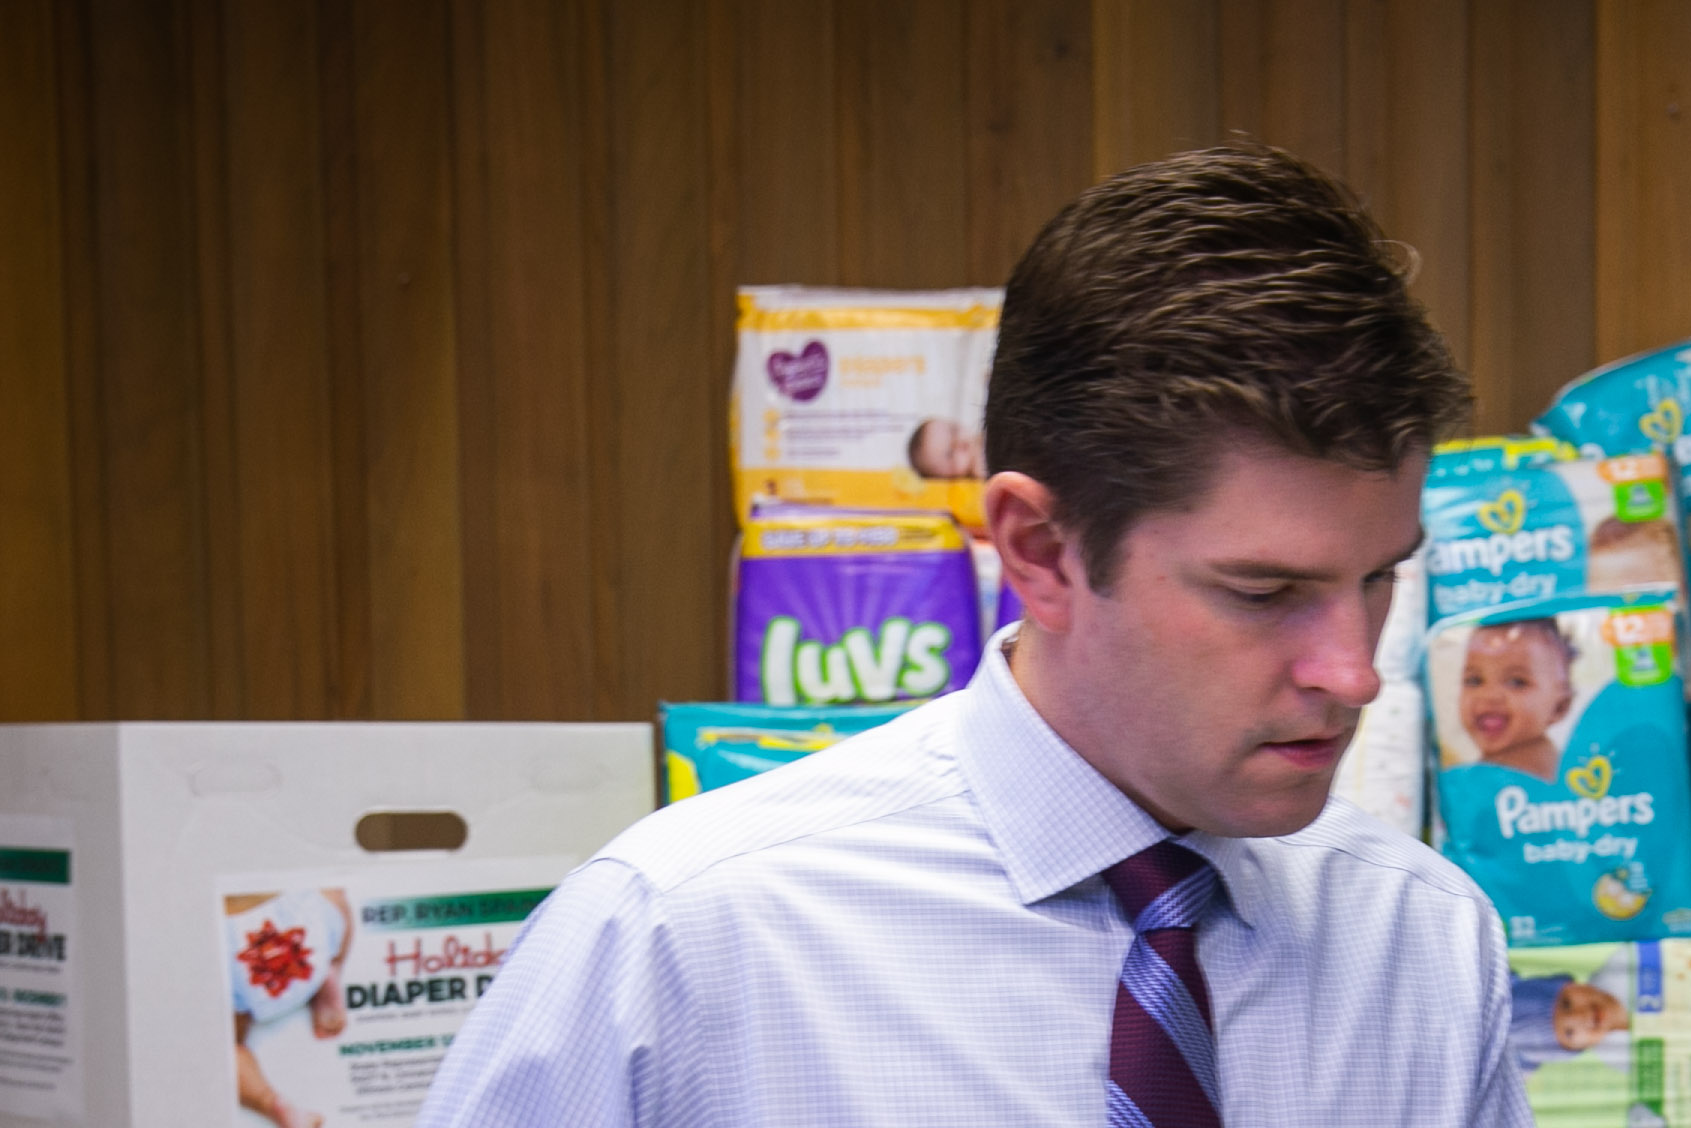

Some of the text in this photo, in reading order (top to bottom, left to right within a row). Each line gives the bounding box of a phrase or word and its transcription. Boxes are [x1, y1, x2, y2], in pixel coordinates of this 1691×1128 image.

[1428, 525, 1573, 575] ampers
[1496, 785, 1655, 839] Pampers
[1523, 834, 1638, 864] baby-dry
[346, 976, 467, 1010] DIAPER
